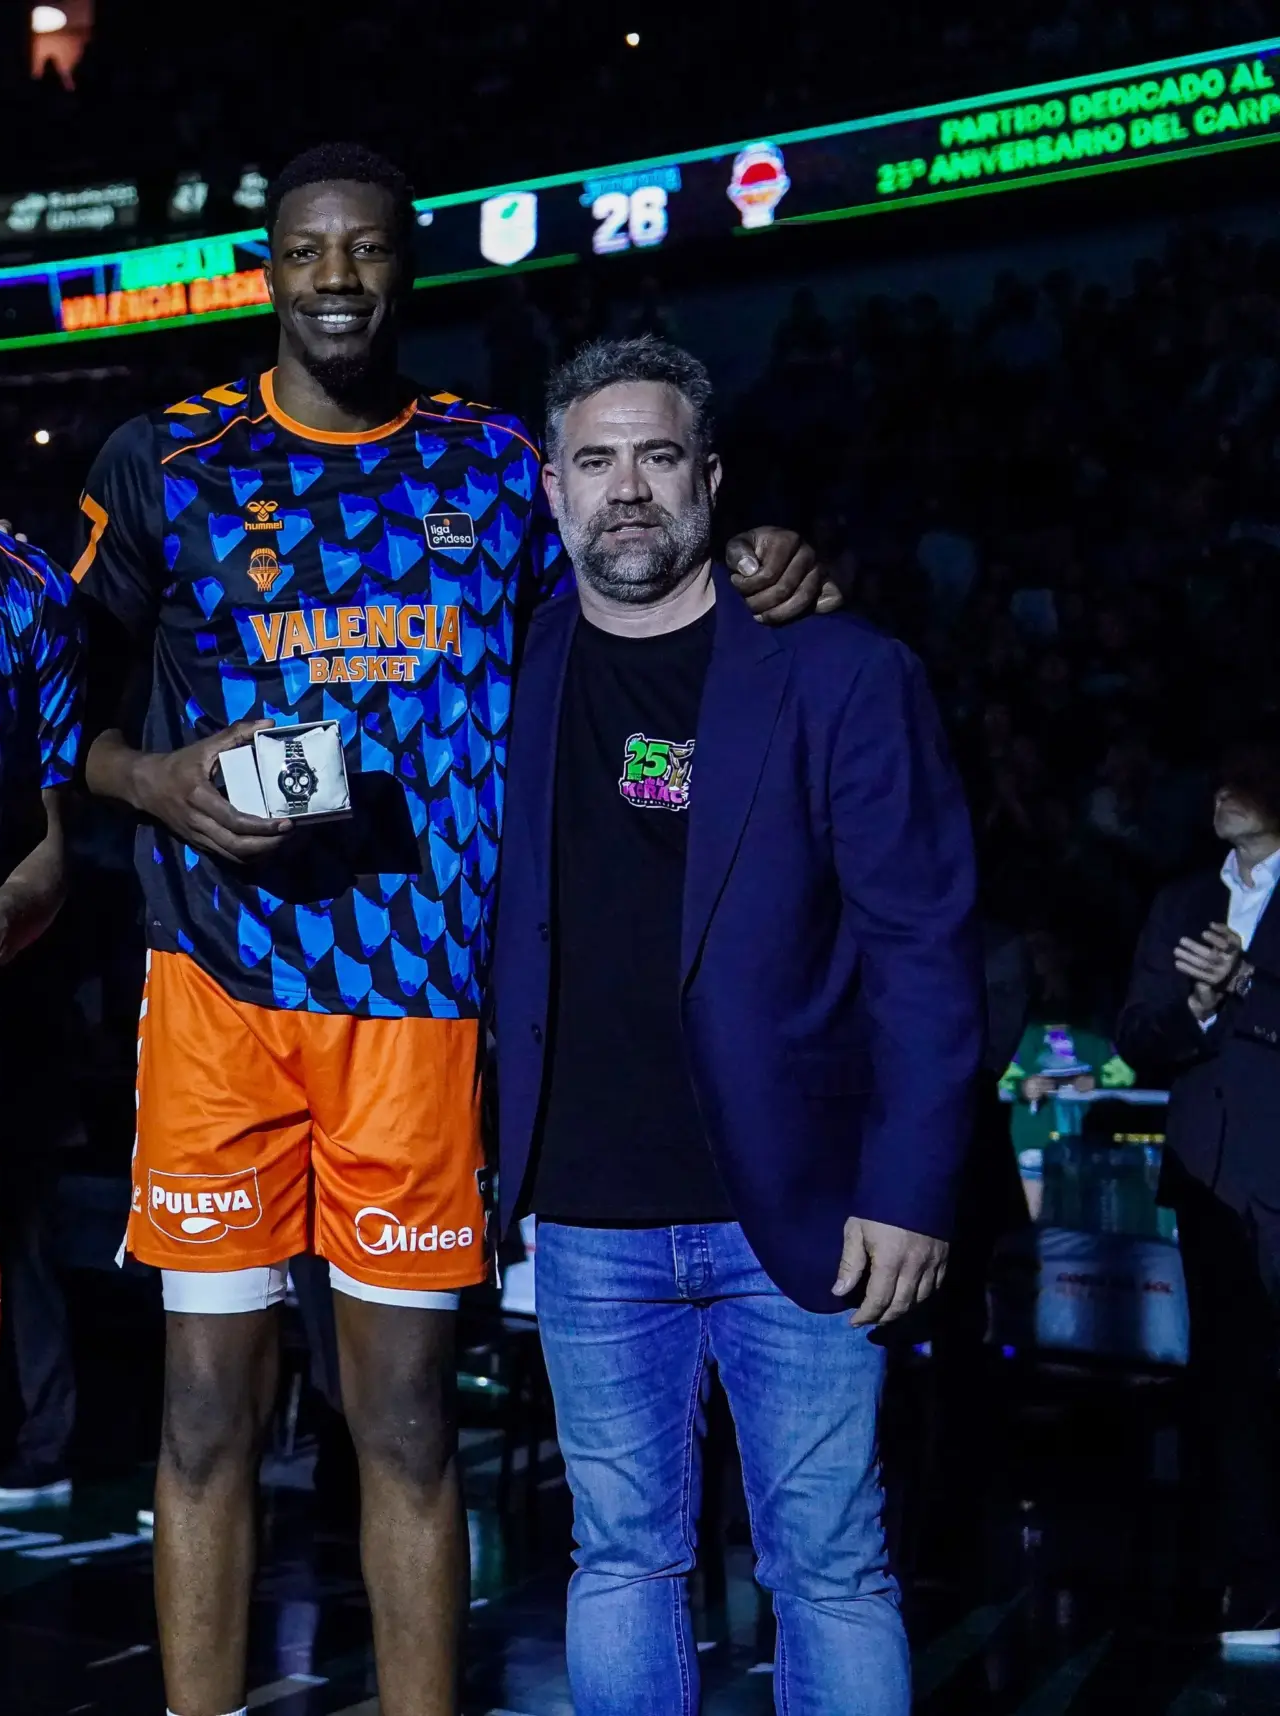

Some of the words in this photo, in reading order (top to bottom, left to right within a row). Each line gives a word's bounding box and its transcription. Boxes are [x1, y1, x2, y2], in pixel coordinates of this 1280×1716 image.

[940, 99, 1065, 148] PARTIDO
[1069, 68, 1225, 122] DEDICADO
[1229, 59, 1275, 95] AL
[928, 120, 1126, 185] ANIVERSARIO
[1130, 112, 1190, 148] DEL
[244, 520, 283, 531] hummel
[430, 524, 450, 536] liga
[432, 533, 472, 544] endesa
[249, 604, 463, 663] VALENCIA
[308, 656, 421, 684] BASKET
[627, 740, 668, 777] 25
[151, 1185, 253, 1215] PULEVA
[370, 1224, 473, 1252] Midea
